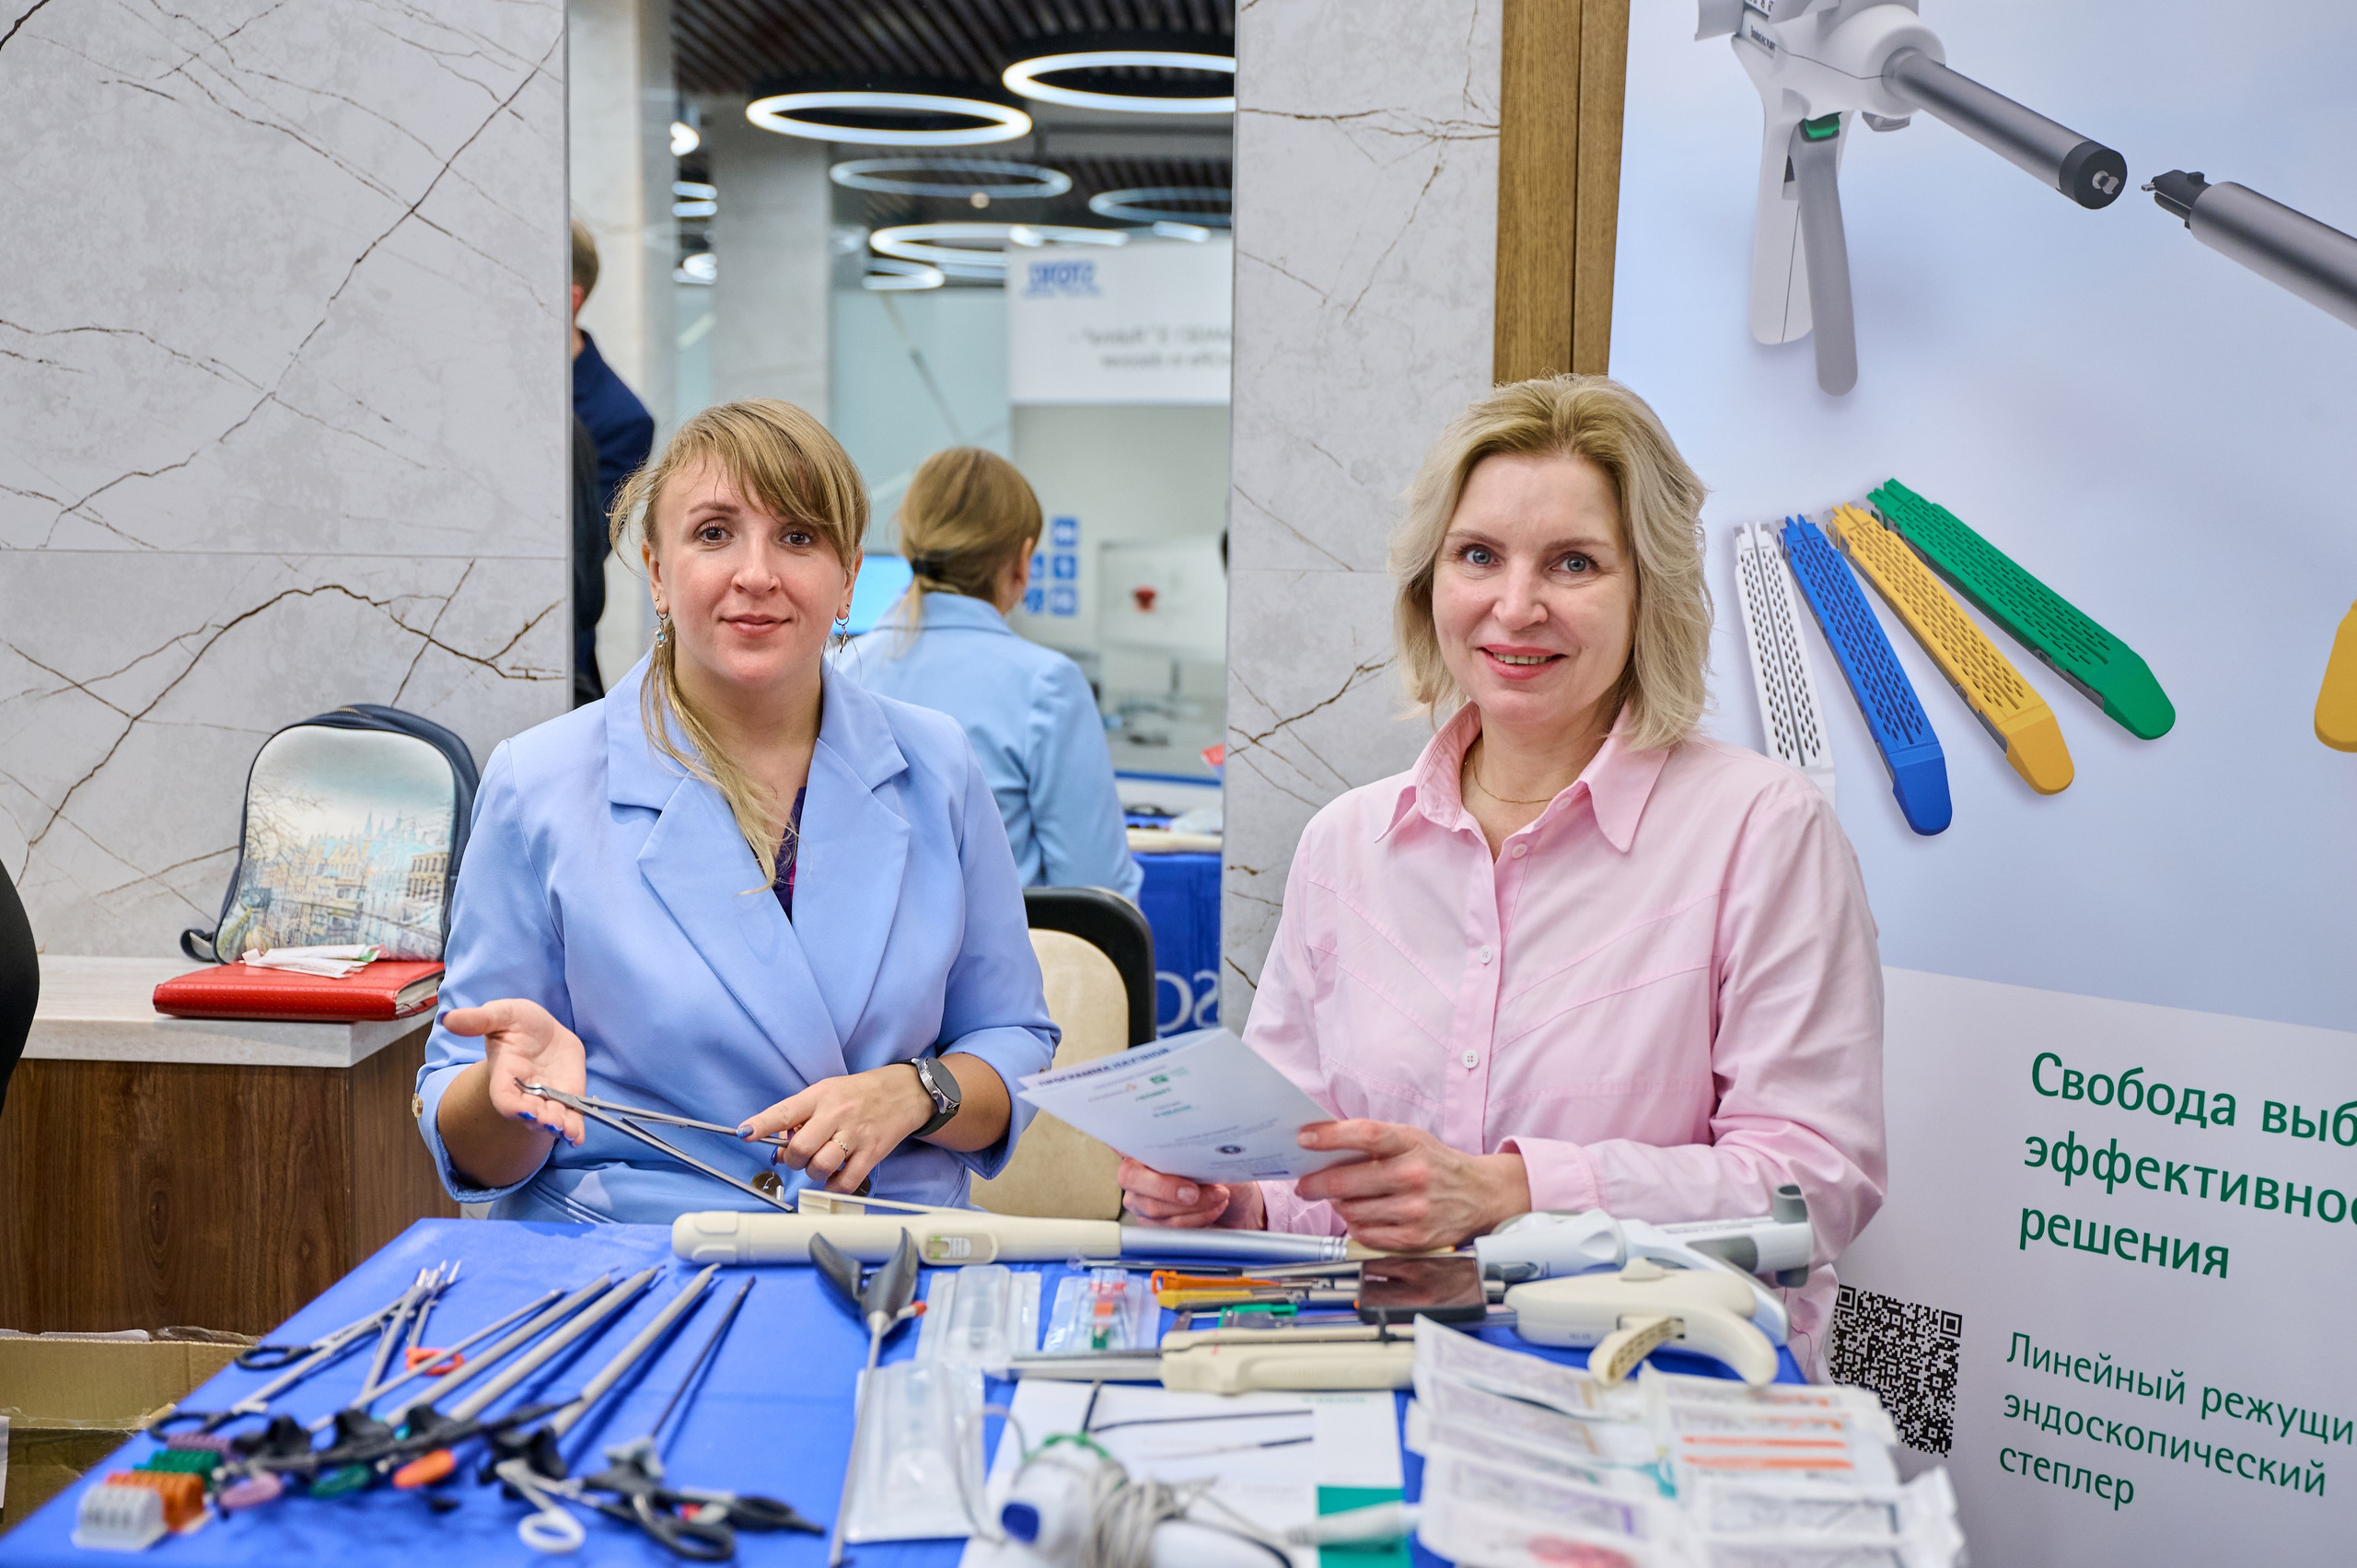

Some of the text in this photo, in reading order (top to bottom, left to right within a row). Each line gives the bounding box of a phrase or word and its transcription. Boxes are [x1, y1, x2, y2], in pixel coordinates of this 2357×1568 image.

[2032, 1051, 2357, 1147] Свобода выб
[2024, 1130, 2357, 1225] эффективно
[2019, 1207, 2229, 1279] решения
[2007, 1331, 2357, 1447] Линейный режущи
[2000, 1447, 2134, 1511] степлер
[2004, 1394, 2326, 1497] эндоскопический
